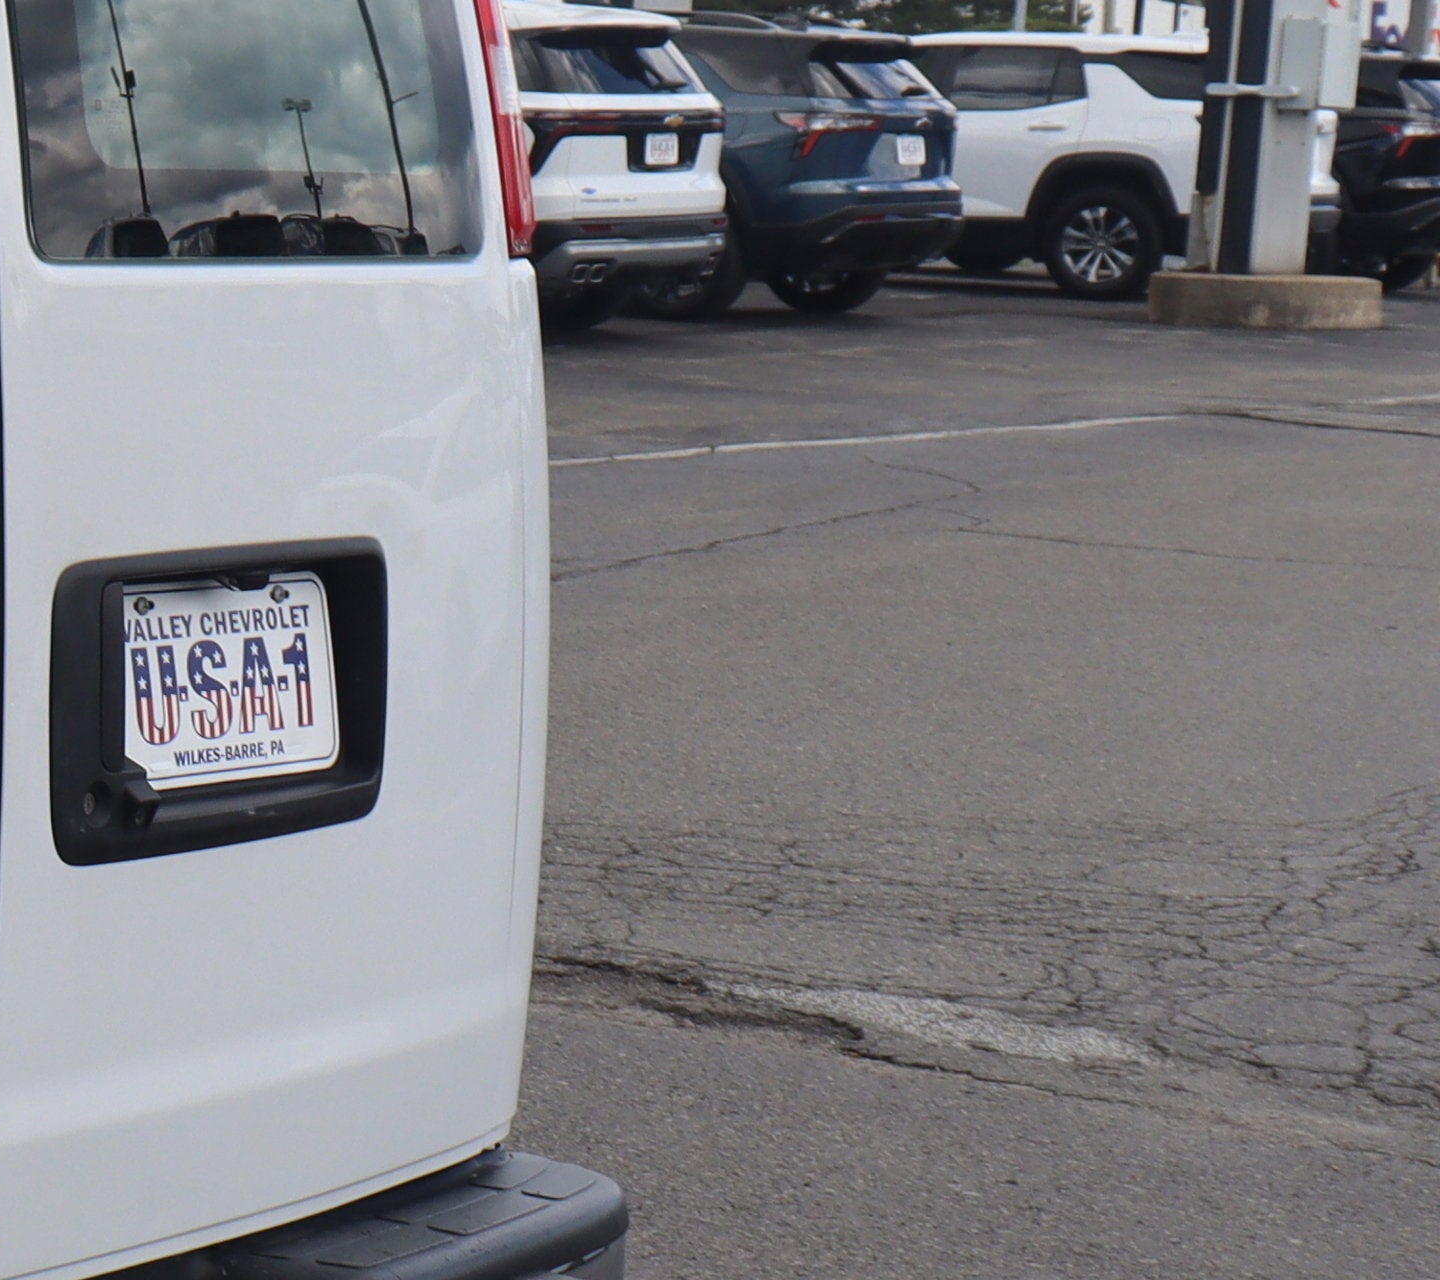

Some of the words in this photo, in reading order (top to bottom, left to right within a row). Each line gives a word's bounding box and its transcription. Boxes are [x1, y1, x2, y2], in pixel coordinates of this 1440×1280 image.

[123, 614, 193, 643] VALLEY
[199, 604, 310, 636] CHEVROLET
[173, 742, 268, 767] WILKES-BARRE,
[270, 740, 285, 756] PA
